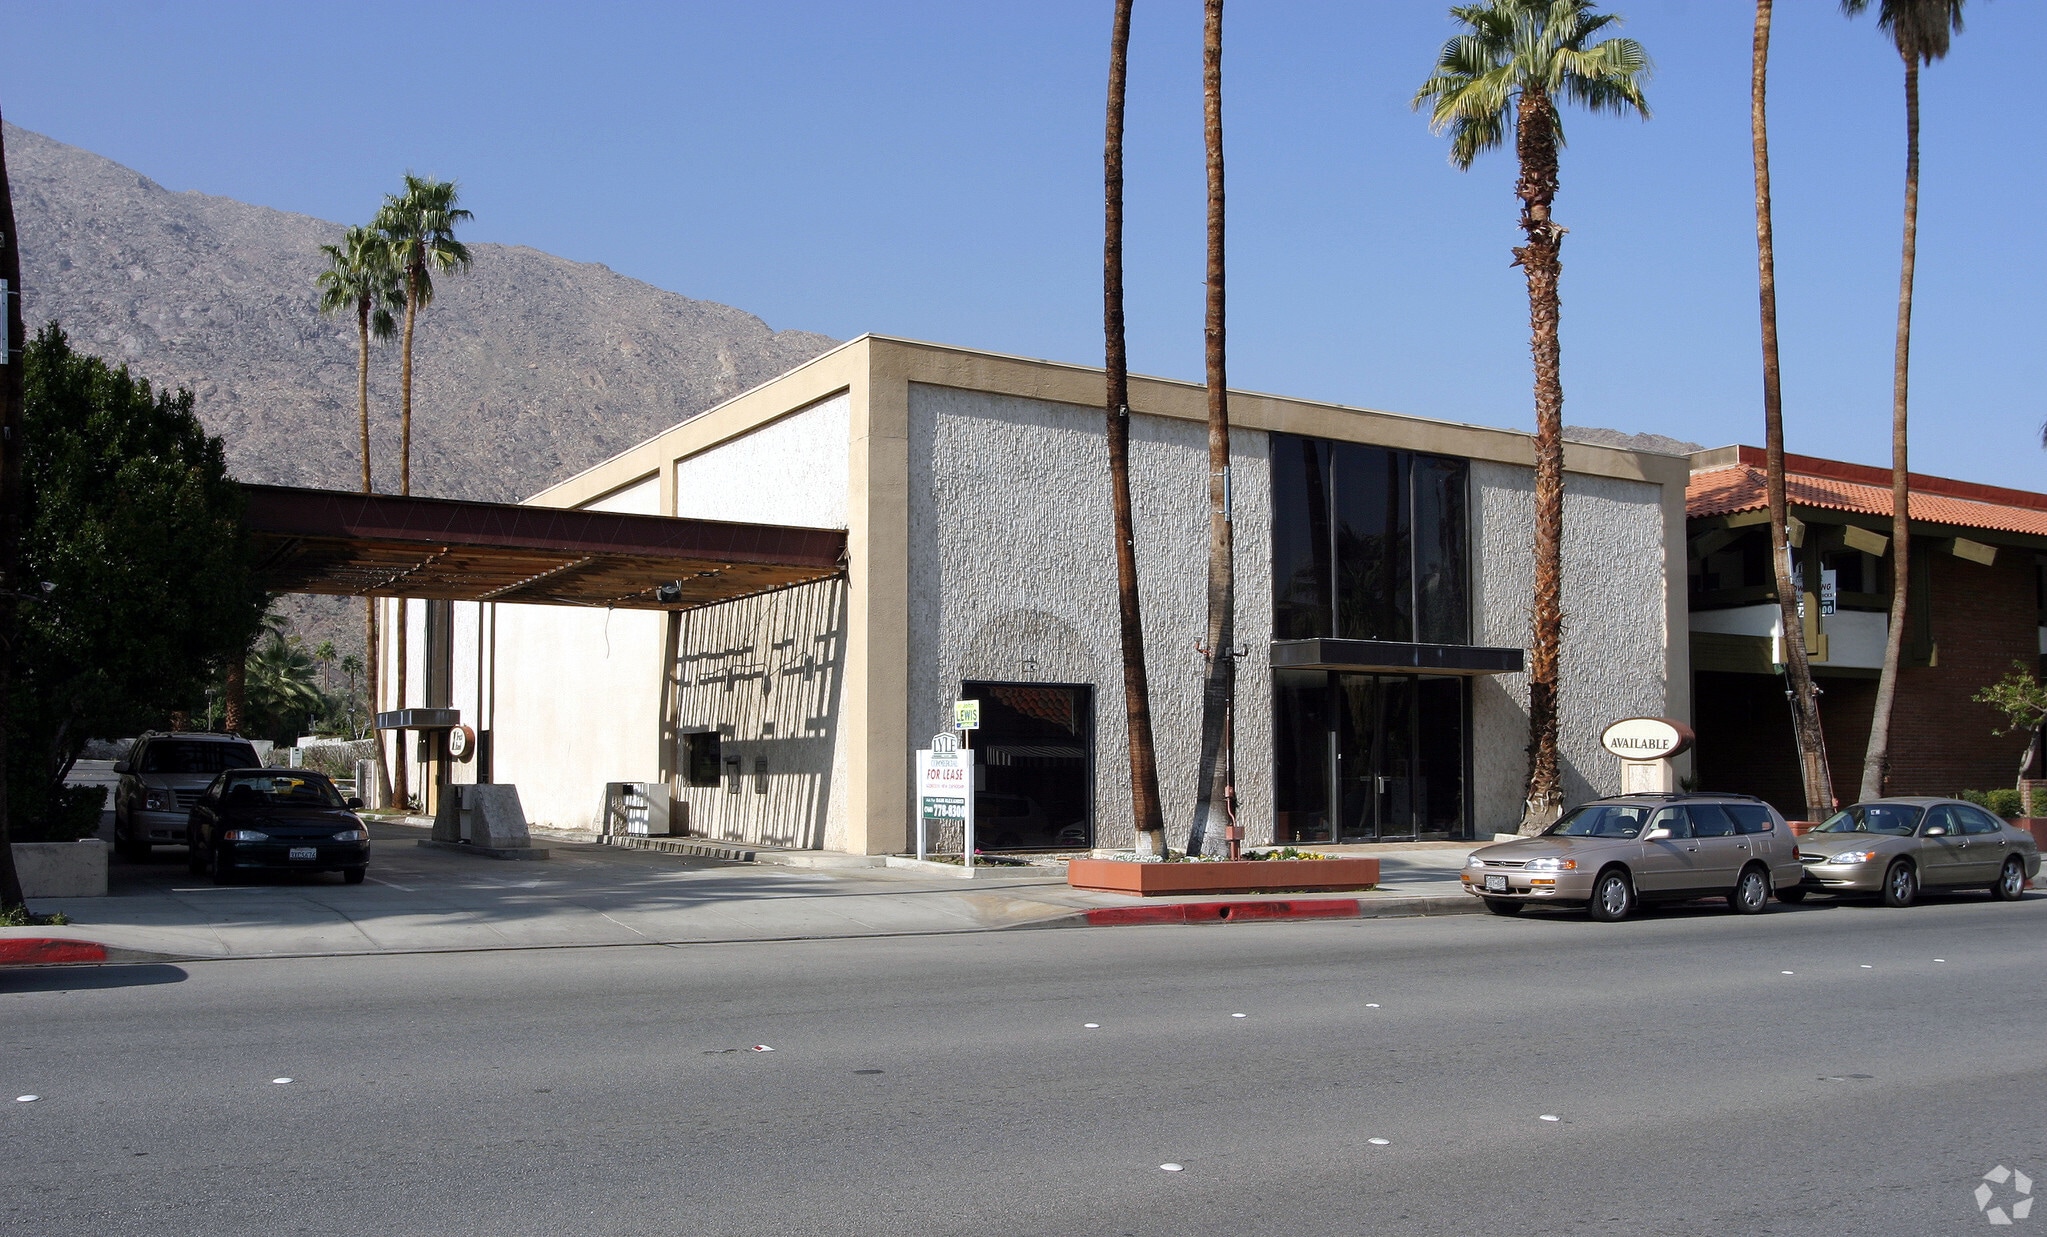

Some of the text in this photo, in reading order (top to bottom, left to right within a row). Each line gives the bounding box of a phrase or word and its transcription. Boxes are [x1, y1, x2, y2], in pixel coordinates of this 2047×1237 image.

[956, 709, 977, 722] LEWIS
[933, 736, 956, 753] LYLE
[1611, 737, 1669, 750] AVAILABLE
[927, 769, 963, 781] FOR LEASE
